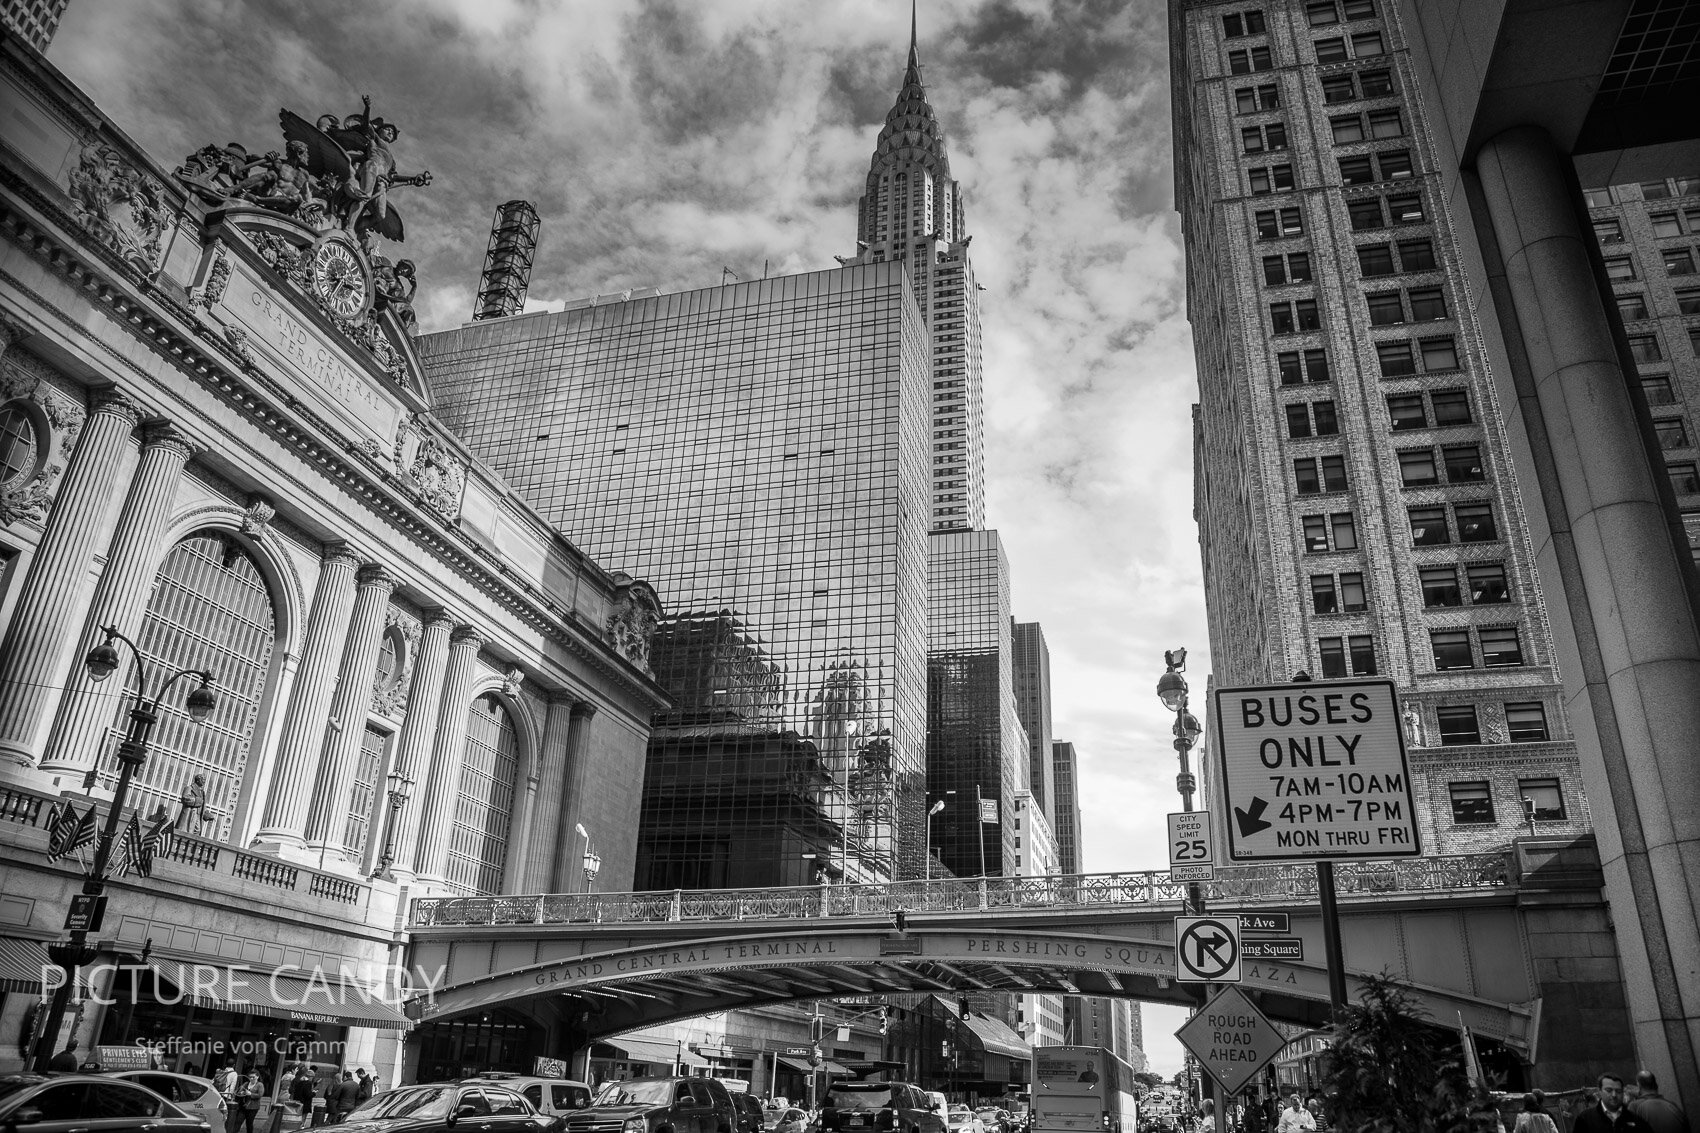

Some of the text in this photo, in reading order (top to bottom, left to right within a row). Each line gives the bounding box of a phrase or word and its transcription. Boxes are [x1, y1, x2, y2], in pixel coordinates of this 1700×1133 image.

[251, 291, 380, 411] GRAND CENTRAL
[279, 331, 351, 403] TERMINAL
[1241, 693, 1372, 728] BUSES
[1259, 734, 1362, 769] ONLY
[1269, 773, 1403, 797] 7AM-10AM
[1279, 800, 1401, 823] 4PM-7PM
[1277, 827, 1409, 847] MON THRU FRI
[1175, 840, 1207, 860] 25
[1240, 917, 1275, 927] rk Ave
[1263, 943, 1299, 956] Square
[535, 941, 837, 986] GRAND CENTRAL TERMINAL
[967, 939, 1298, 985] PERSHING SQUA AZA
[291, 1011, 339, 1024] BANANA REPUBLIC
[1208, 1014, 1256, 1028] ROUGH
[1213, 1031, 1251, 1045] ROAD
[102, 1048, 148, 1058] PRIVATE EYES
[1209, 1048, 1257, 1062] AHEAD
